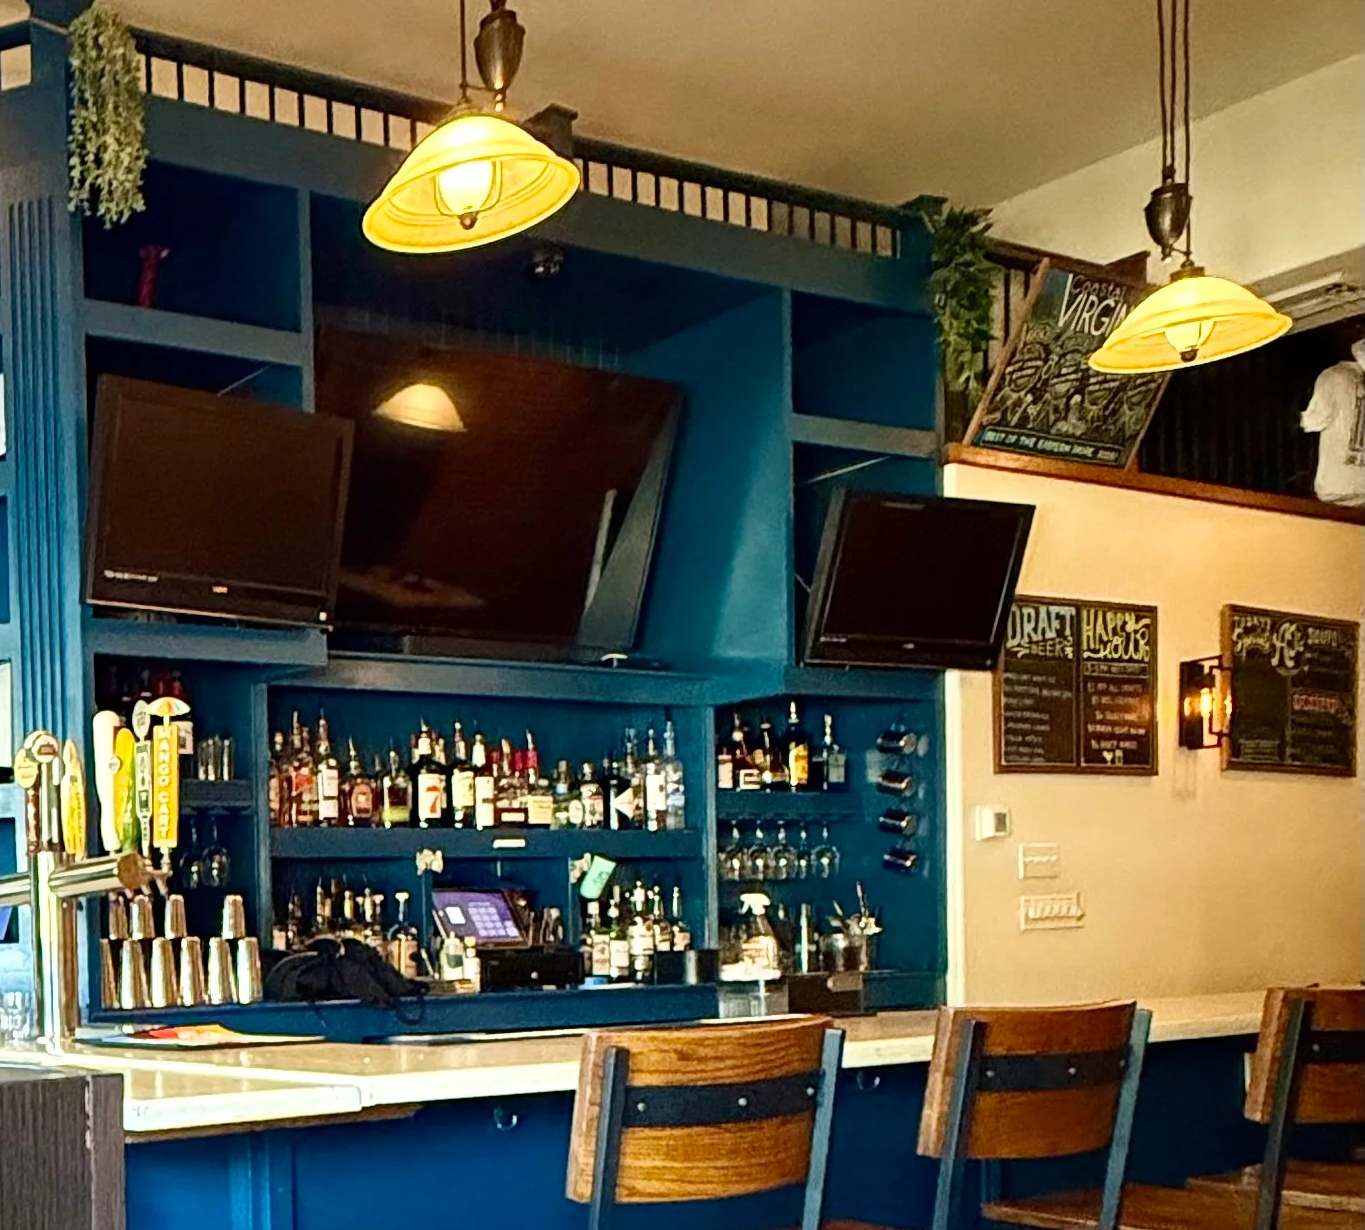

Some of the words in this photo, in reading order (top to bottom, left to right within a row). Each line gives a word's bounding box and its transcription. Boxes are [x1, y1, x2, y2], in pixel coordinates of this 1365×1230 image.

[1071, 273, 1128, 299] Coastal
[1005, 434, 1018, 444] OF
[1018, 436, 1036, 447] THE
[1006, 605, 1076, 649] DRAFT
[157, 727, 171, 788] MANGO
[157, 791, 171, 840] CART
[425, 785, 441, 815] 7
